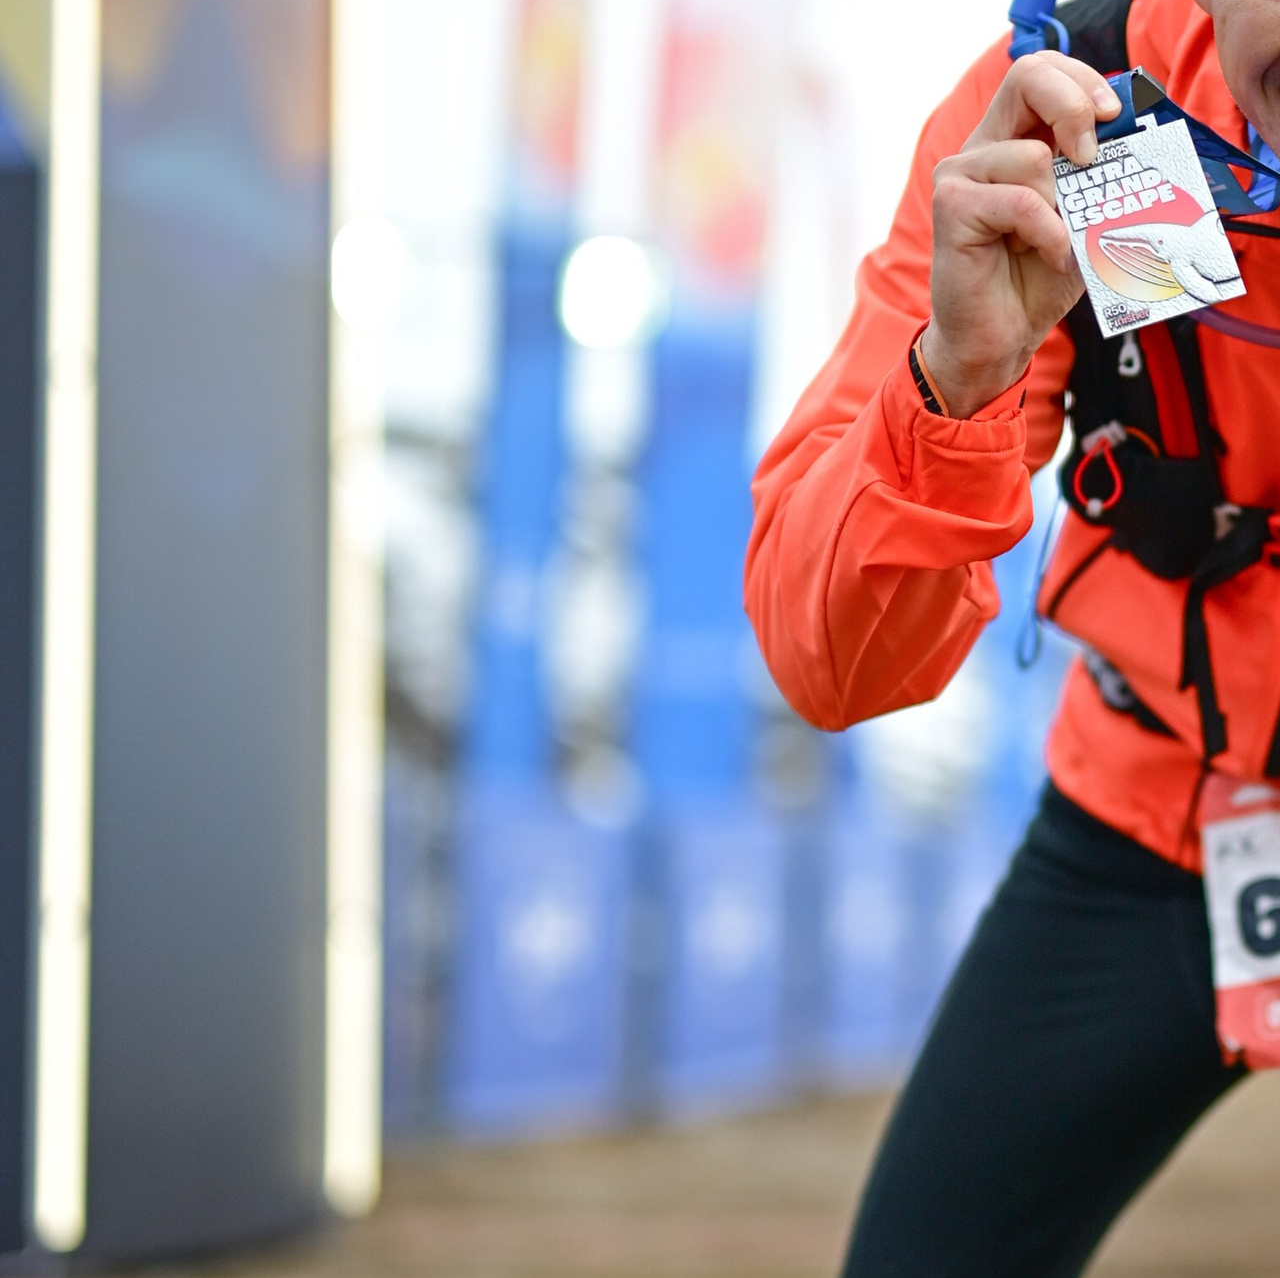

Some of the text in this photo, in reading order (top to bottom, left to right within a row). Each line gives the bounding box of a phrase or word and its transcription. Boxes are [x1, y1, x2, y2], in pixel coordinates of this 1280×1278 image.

[1104, 143, 1129, 160] 2025
[1056, 156, 1143, 195] ULTRA
[1063, 169, 1162, 212] GRAND
[1069, 183, 1176, 230] ESCAPE
[1104, 304, 1127, 319] R50
[1107, 309, 1150, 330] Finisher
